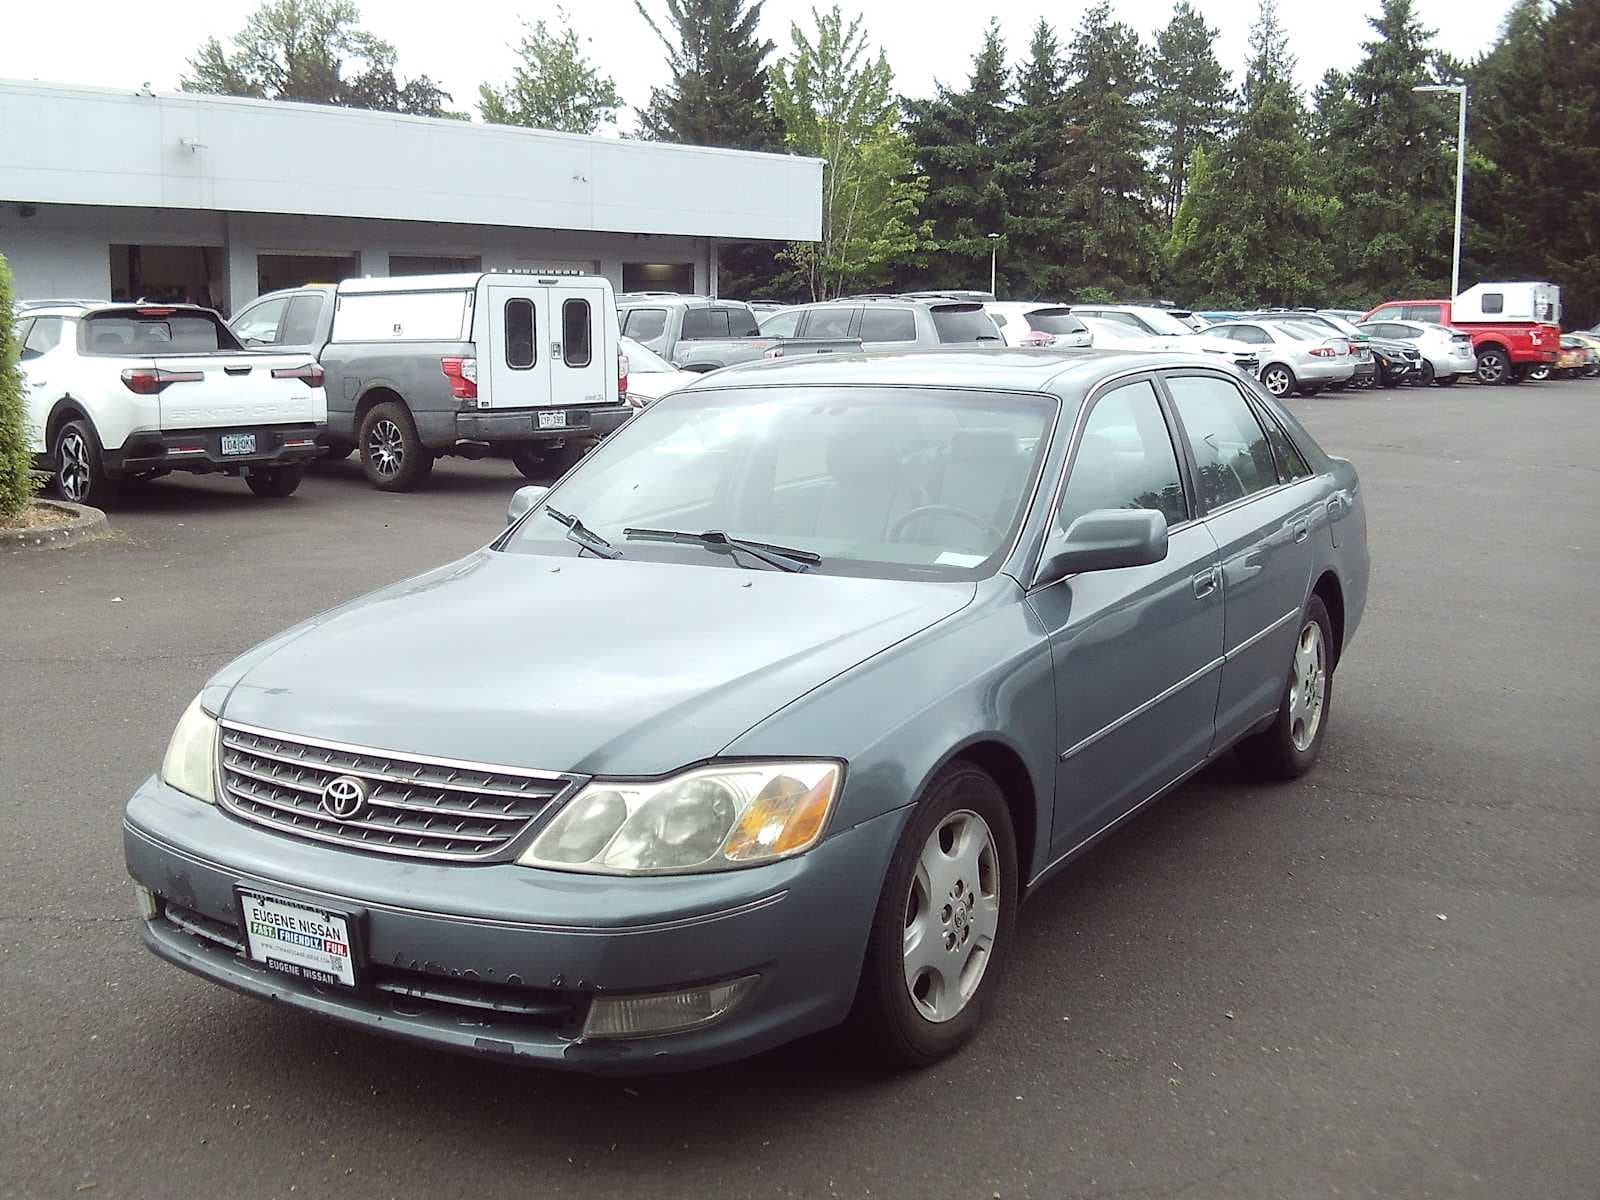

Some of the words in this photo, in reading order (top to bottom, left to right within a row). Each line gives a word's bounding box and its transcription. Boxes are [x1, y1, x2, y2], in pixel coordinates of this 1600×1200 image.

[252, 908, 296, 930] EUGENE
[299, 920, 341, 941] NISSAN
[253, 924, 276, 938] FAST.
[279, 931, 322, 950] FRIENDLY.
[326, 945, 347, 957] FUN.
[269, 959, 300, 976] EUGENE
[303, 968, 334, 985] NISSAN
